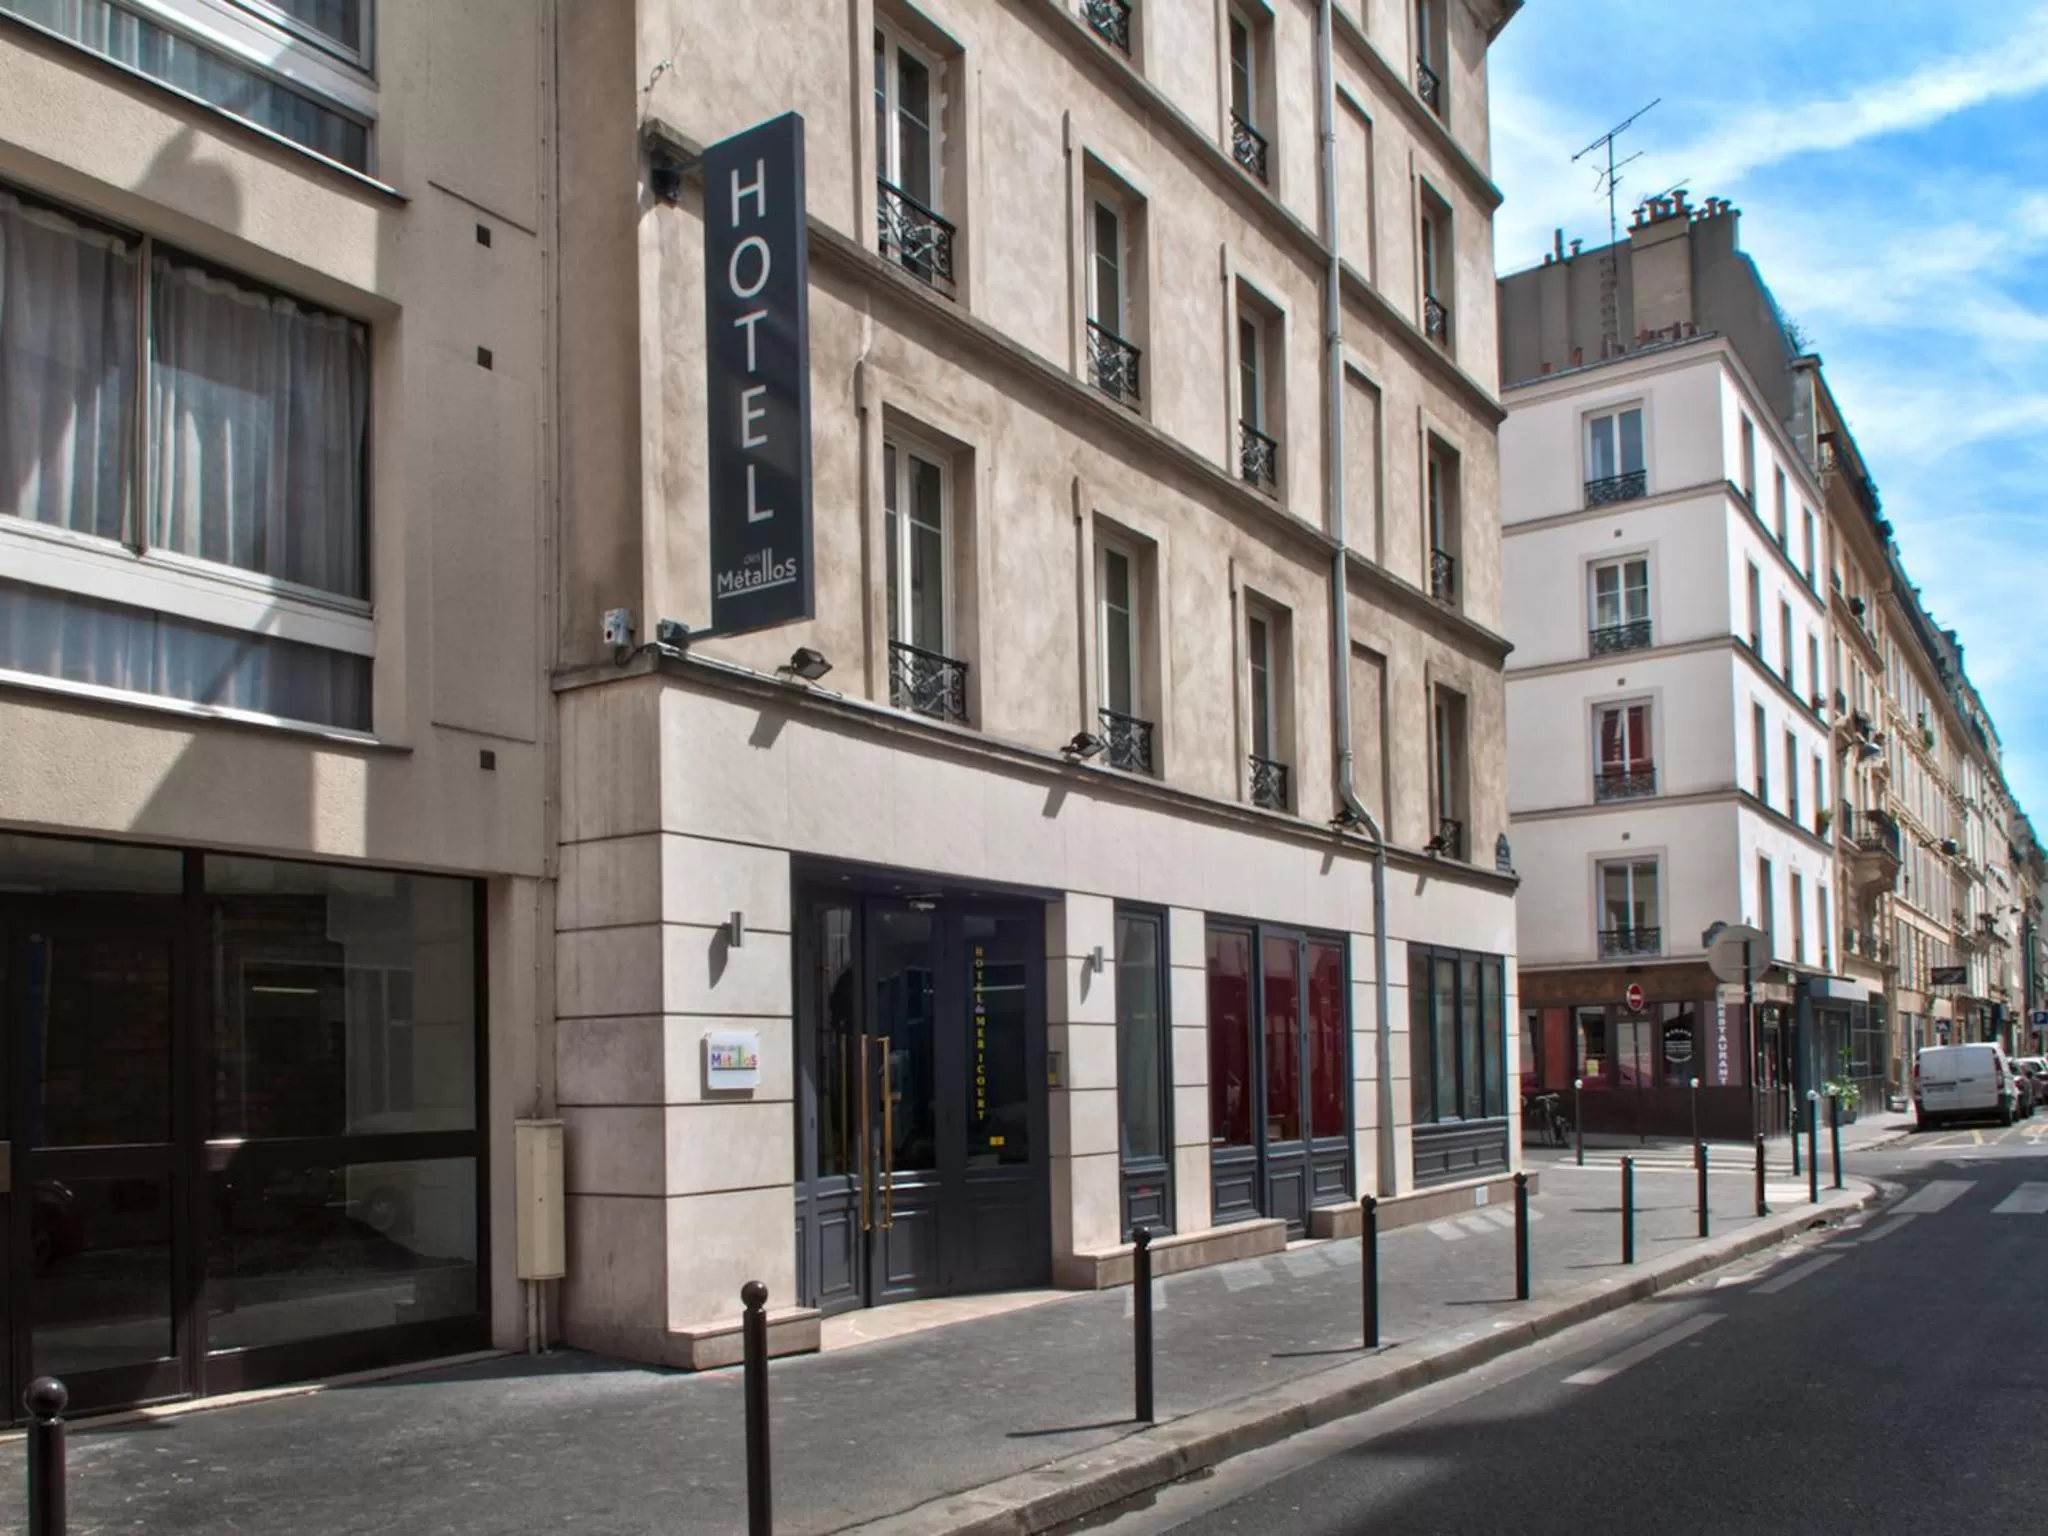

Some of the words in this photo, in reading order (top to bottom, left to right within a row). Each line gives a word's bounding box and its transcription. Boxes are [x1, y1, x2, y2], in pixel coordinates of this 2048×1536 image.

[728, 157, 774, 524] HOTEL
[716, 547, 797, 593] Métallos
[1716, 1001, 1729, 1085] RESTAURANT
